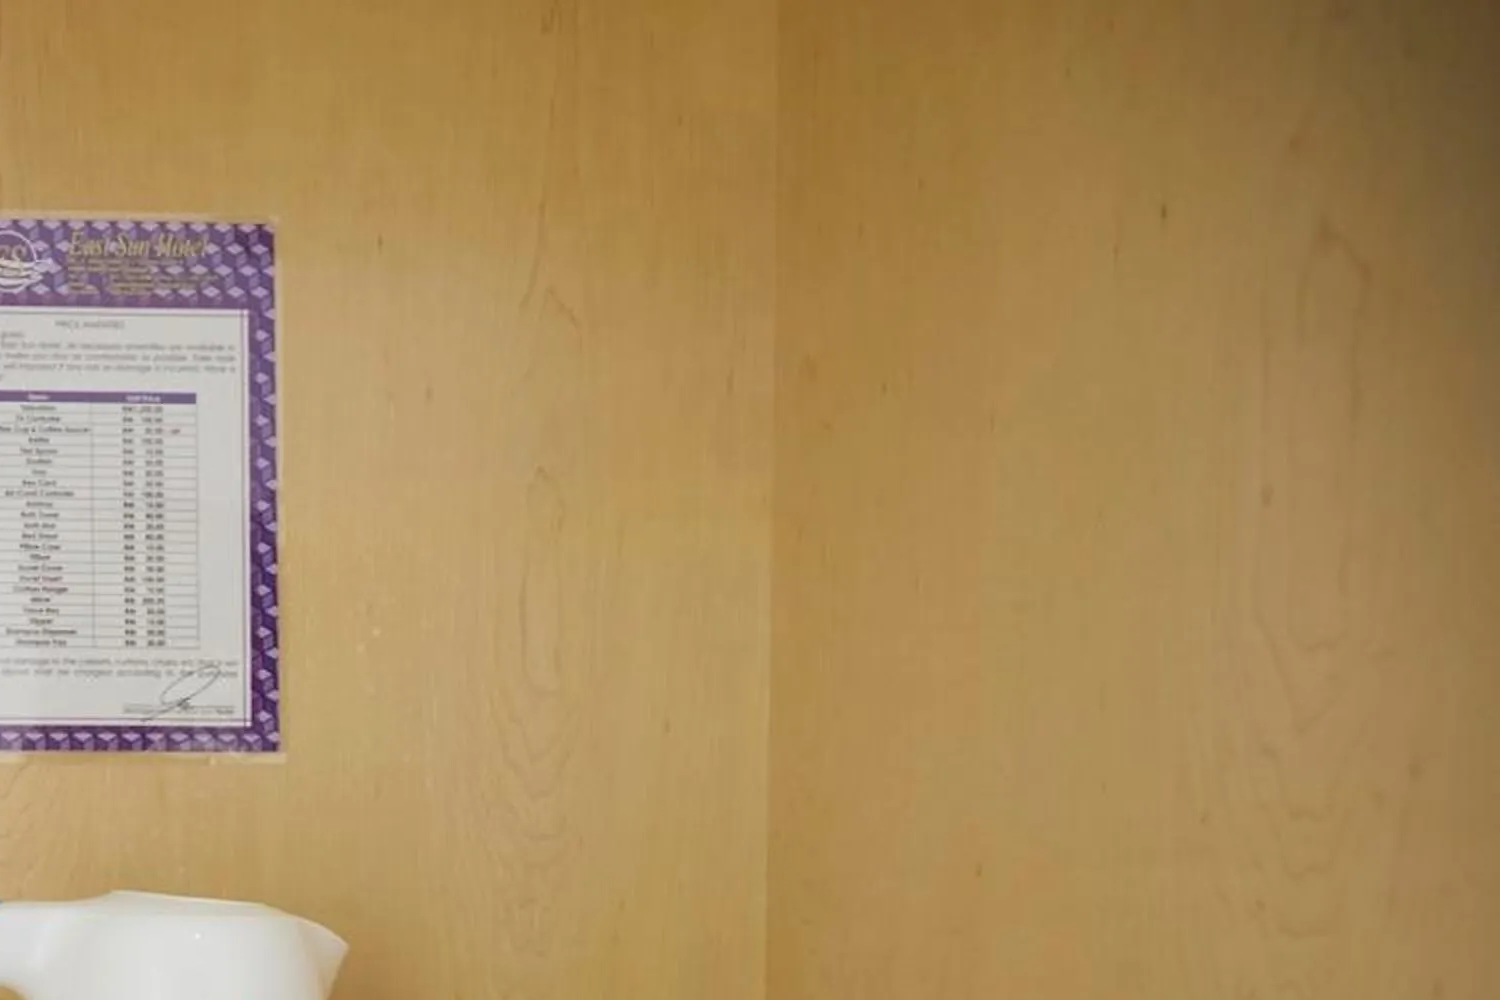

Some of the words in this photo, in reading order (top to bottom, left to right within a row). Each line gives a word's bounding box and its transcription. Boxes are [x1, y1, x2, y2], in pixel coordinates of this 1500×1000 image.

[68, 231, 109, 257] East
[116, 232, 150, 257] Sun
[157, 231, 209, 257] Hotel
